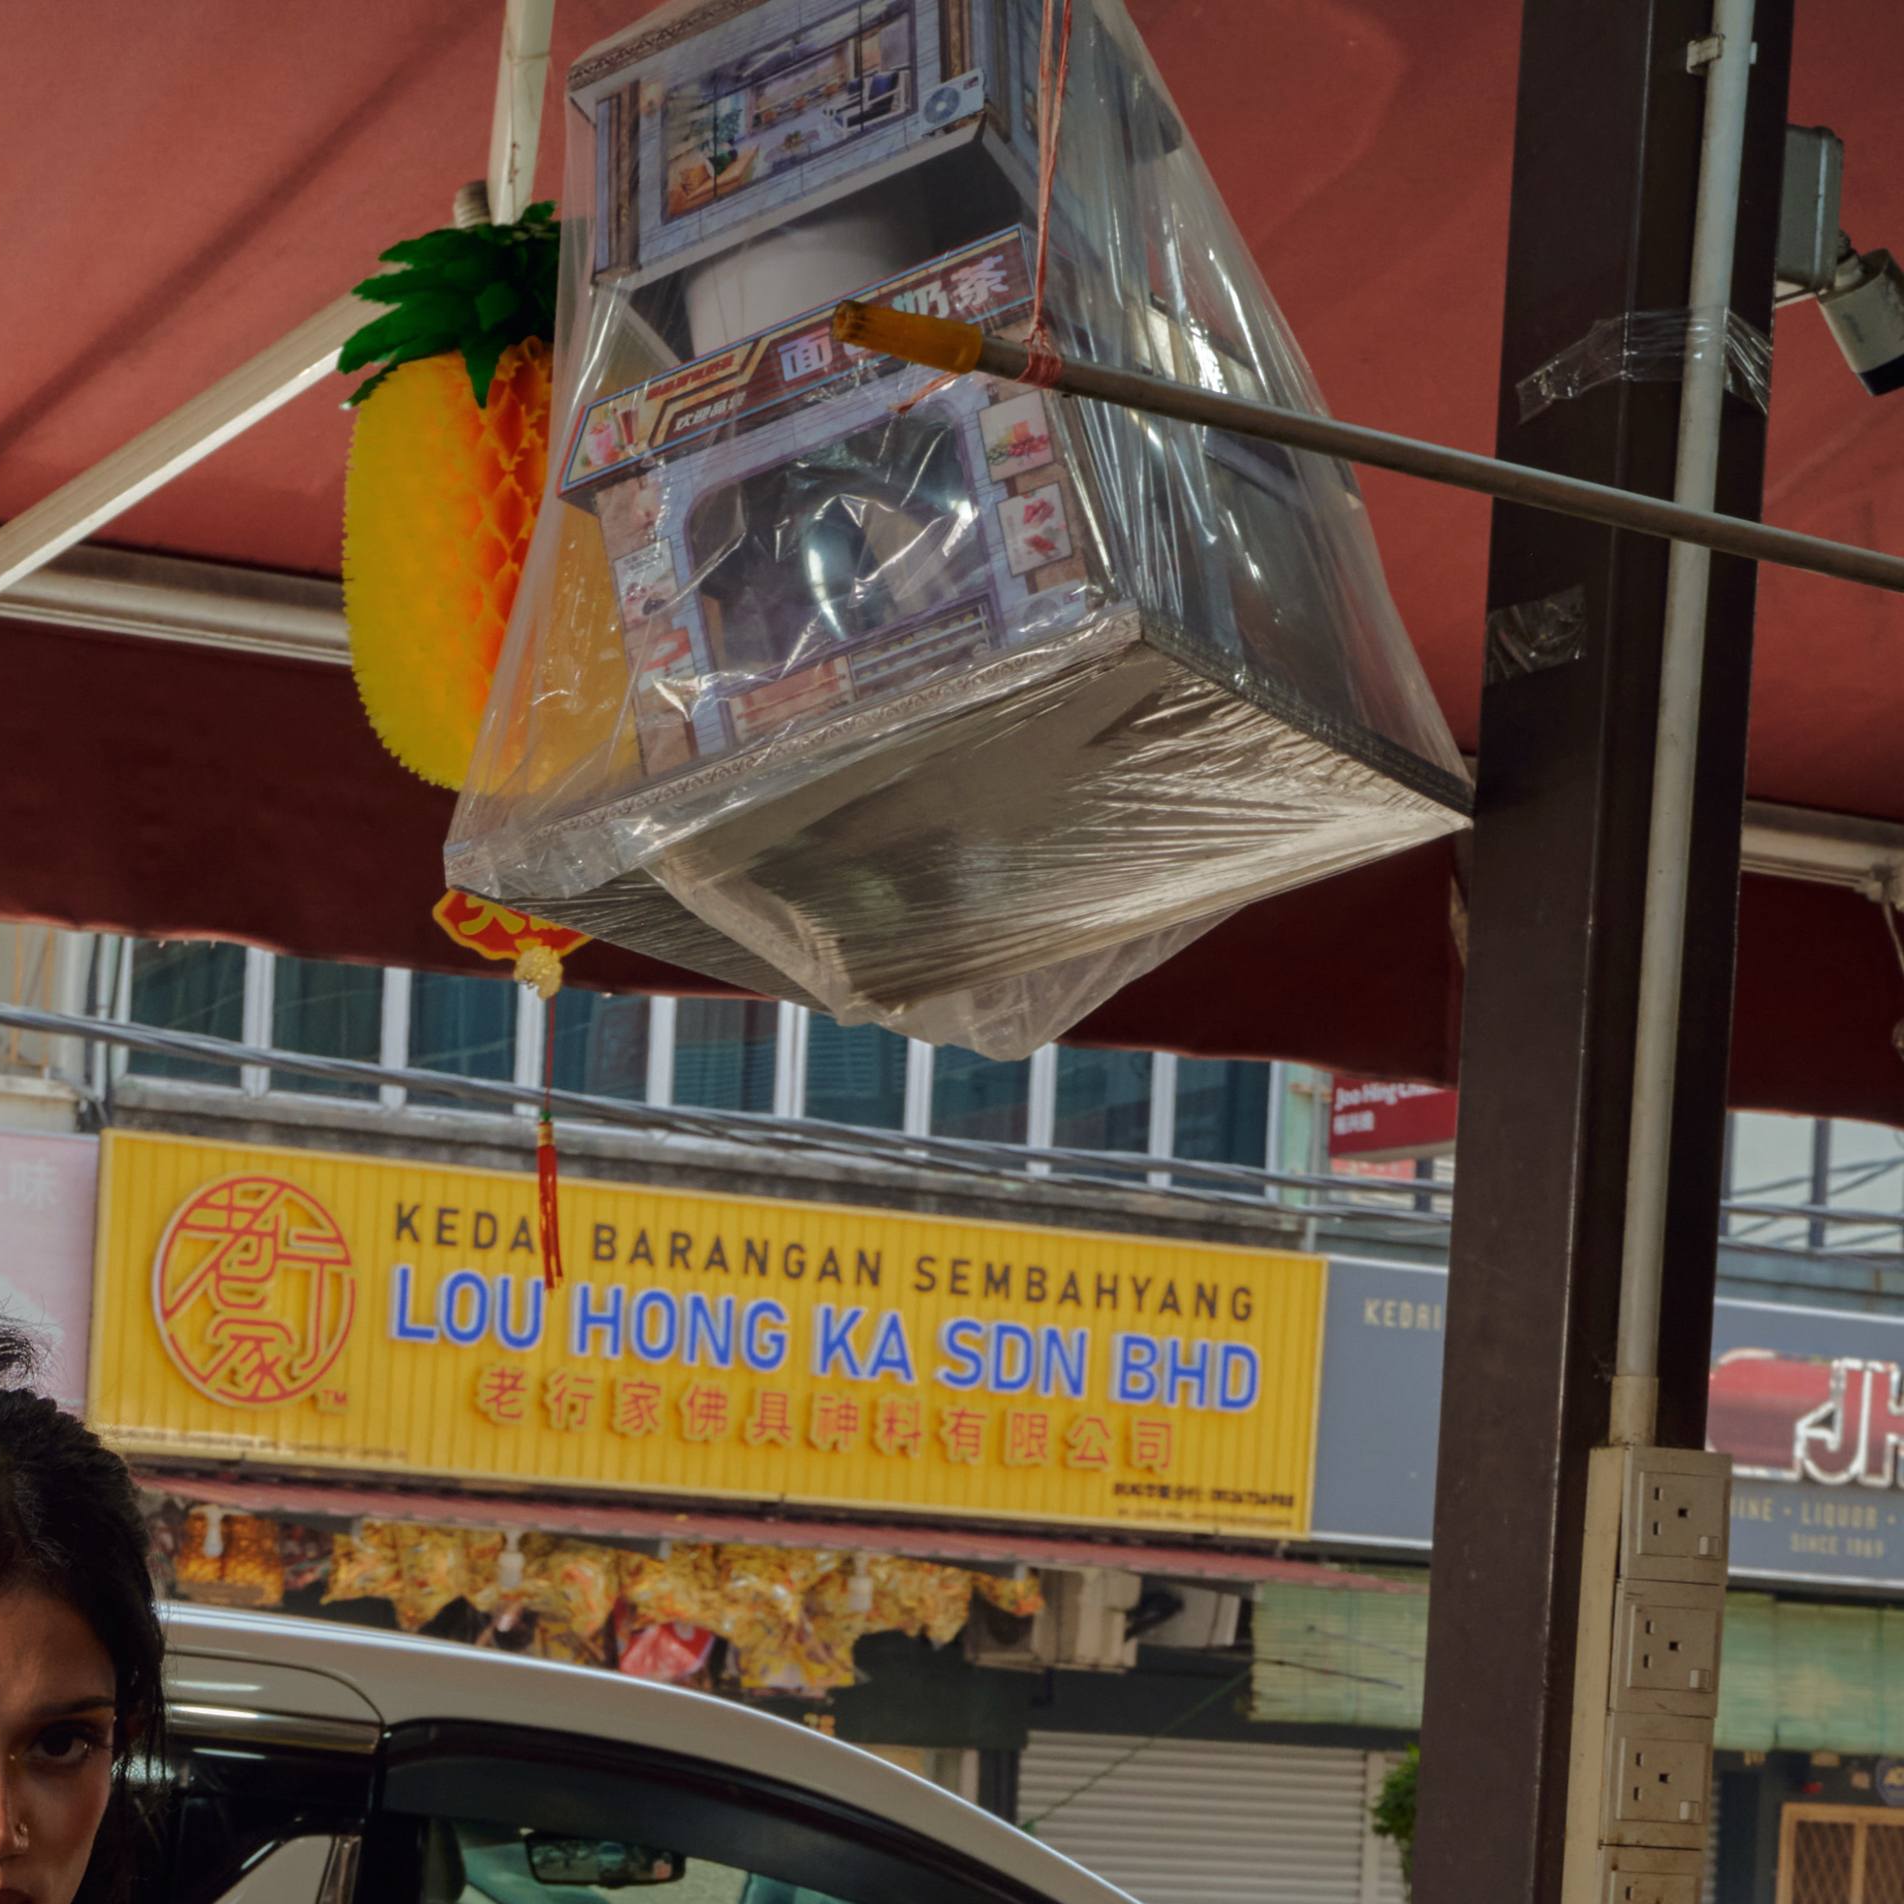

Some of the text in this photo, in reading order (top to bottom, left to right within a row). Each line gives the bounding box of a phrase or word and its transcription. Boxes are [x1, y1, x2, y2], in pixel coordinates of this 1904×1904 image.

[394, 1202, 1254, 1322] KEDA BARANGAN SEMBAHYANG
[395, 1264, 1259, 1411] LOU HONG KA SDN BHD
[1730, 1496, 1774, 1523] INE
